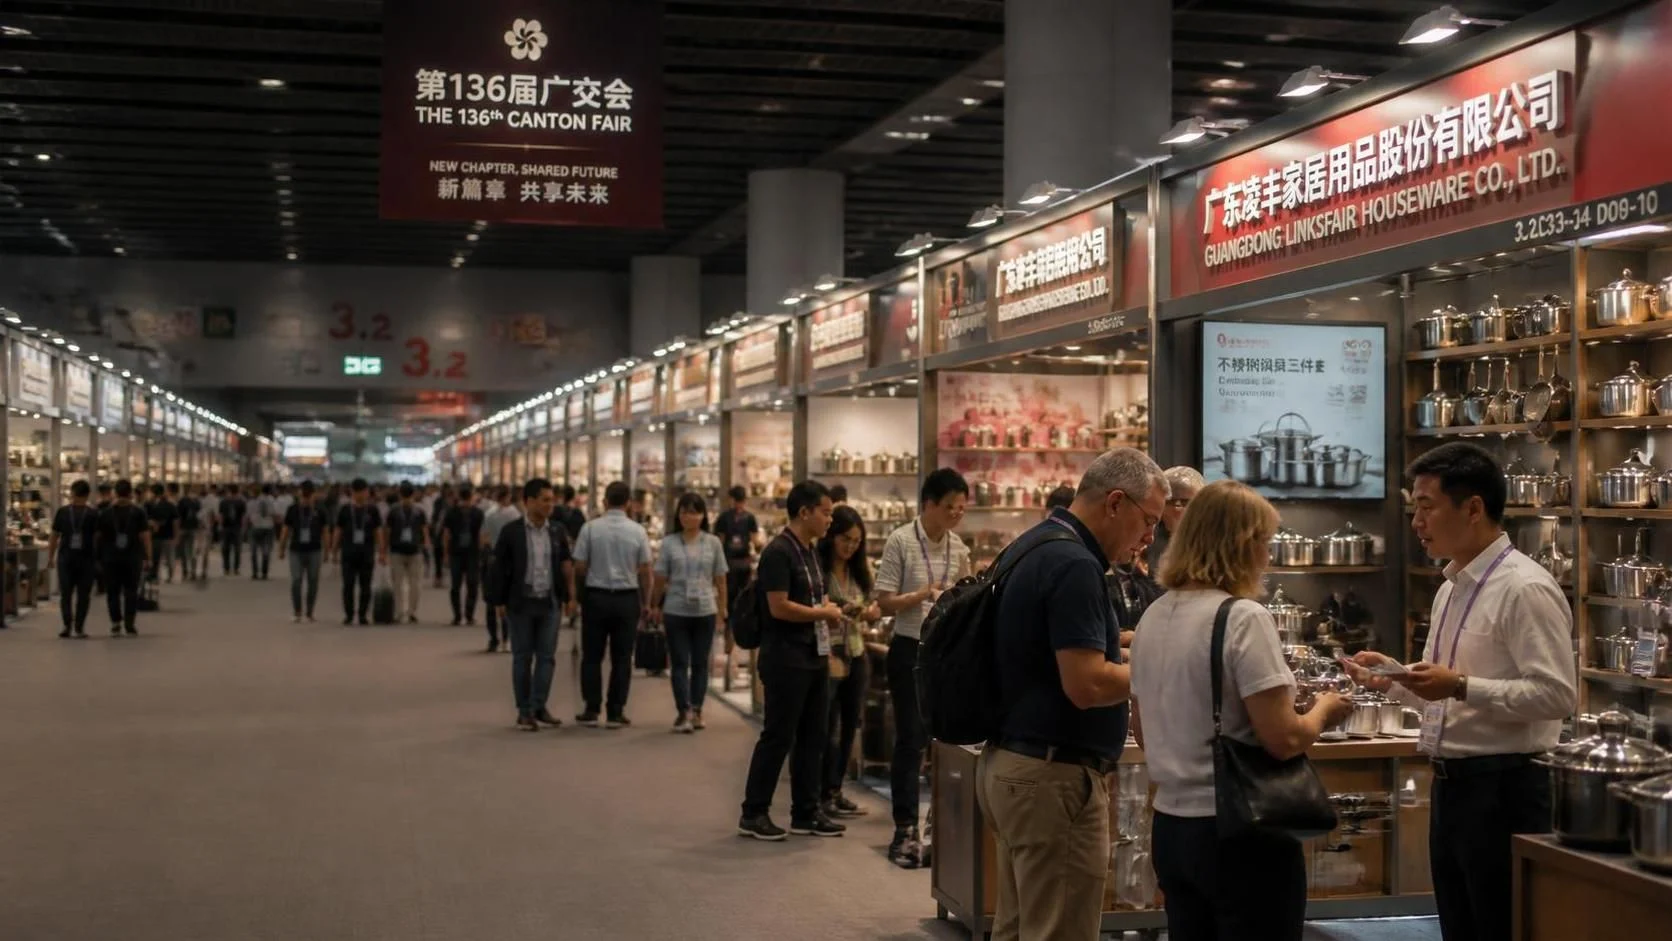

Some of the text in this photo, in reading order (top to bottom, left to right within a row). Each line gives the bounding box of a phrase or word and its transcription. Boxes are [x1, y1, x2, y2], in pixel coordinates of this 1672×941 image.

[415, 69, 634, 110] 第136届广交会
[415, 106, 633, 132] THE 136th CANTON FAIR
[429, 160, 619, 179] NEW CHAPTER, SHARED FUTURE
[1203, 70, 1564, 234] 广东凌丰家居用品股份有限公司
[520, 181, 609, 205] 共享未来
[1204, 148, 1562, 267] GUANGDONG LINKSFAIR HOUSEWARE CO., LTD.
[328, 300, 394, 340] 3.2
[401, 336, 468, 379] 3.2
